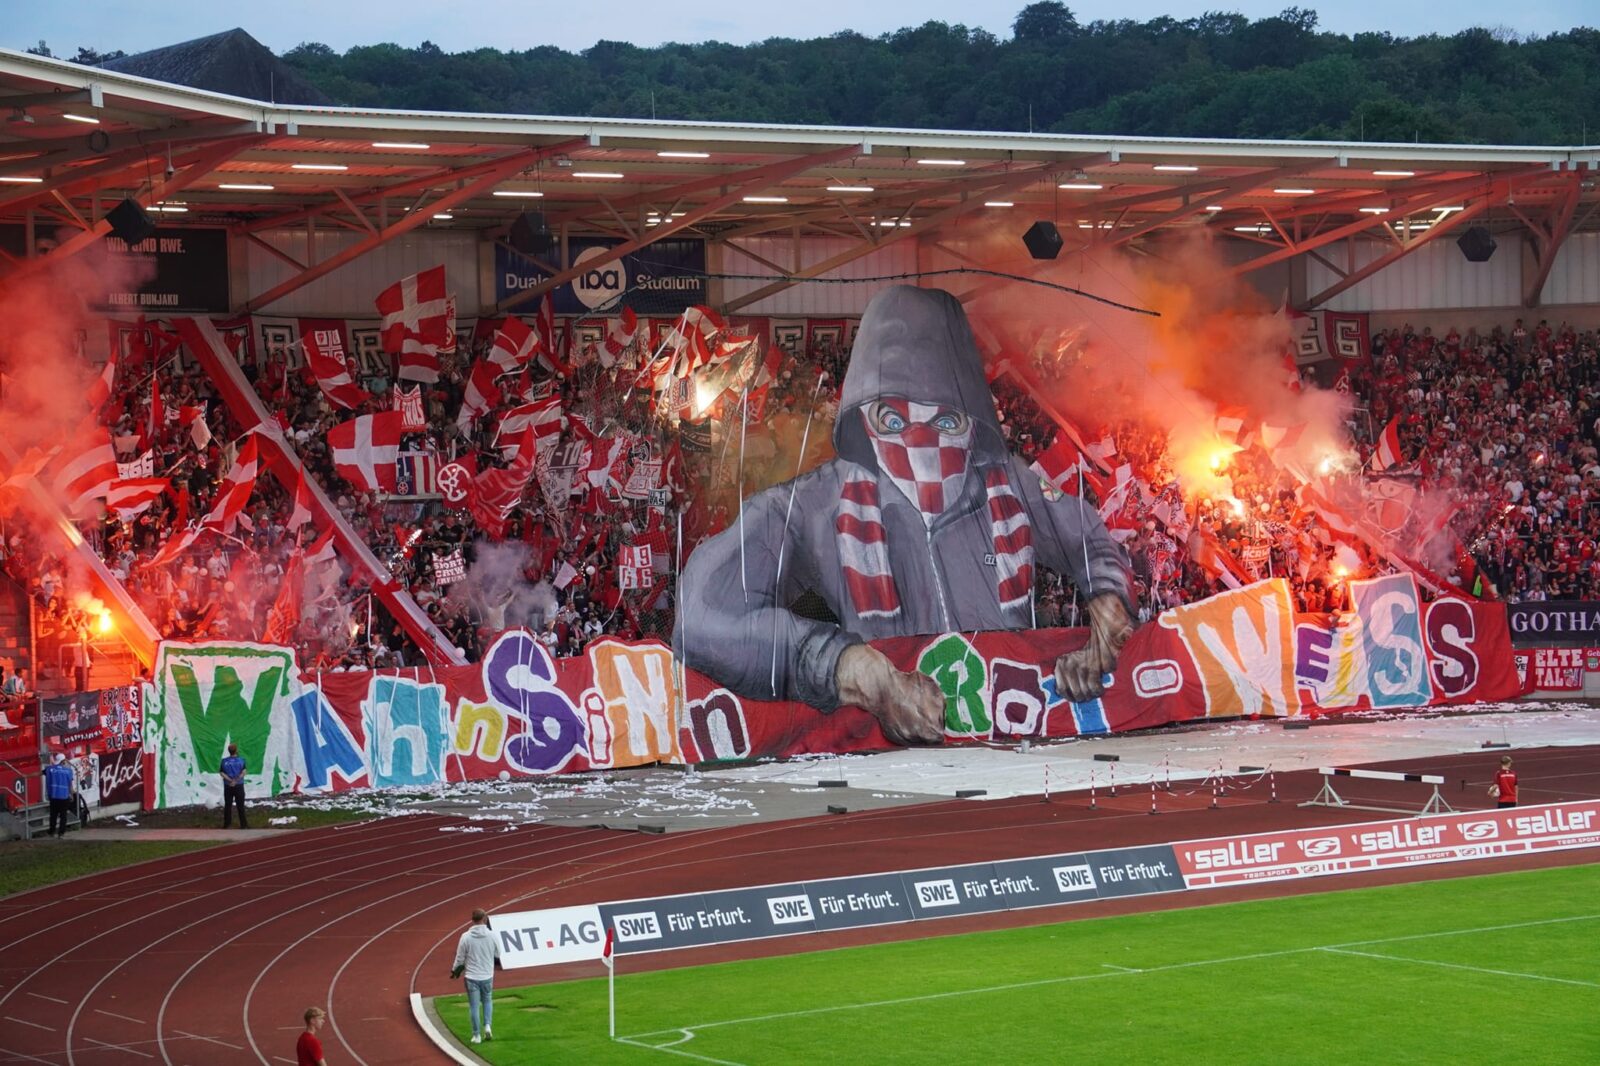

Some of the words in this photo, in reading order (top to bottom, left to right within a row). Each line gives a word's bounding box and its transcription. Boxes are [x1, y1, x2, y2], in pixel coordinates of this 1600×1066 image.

[160, 238, 186, 253] RWE.
[636, 274, 700, 290] Studium
[108, 293, 138, 305] ALBERT
[140, 293, 179, 306] BUNJAKU
[1535, 649, 1583, 667] ELTE
[1535, 667, 1564, 687] TAL
[1059, 869, 1091, 887] SWE
[1099, 865, 1123, 883] Für
[1125, 861, 1173, 880] Erfurt.
[920, 884, 954, 903] SWE
[963, 880, 989, 899] Für
[990, 875, 1040, 896] Erfurt.
[773, 898, 809, 919] SWE
[820, 894, 846, 915] Für
[848, 889, 900, 911] Erfurt.
[619, 917, 657, 937] SWE
[667, 912, 694, 933] Für
[696, 906, 752, 929] Erfurt.
[500, 921, 600, 953] NT.AG
